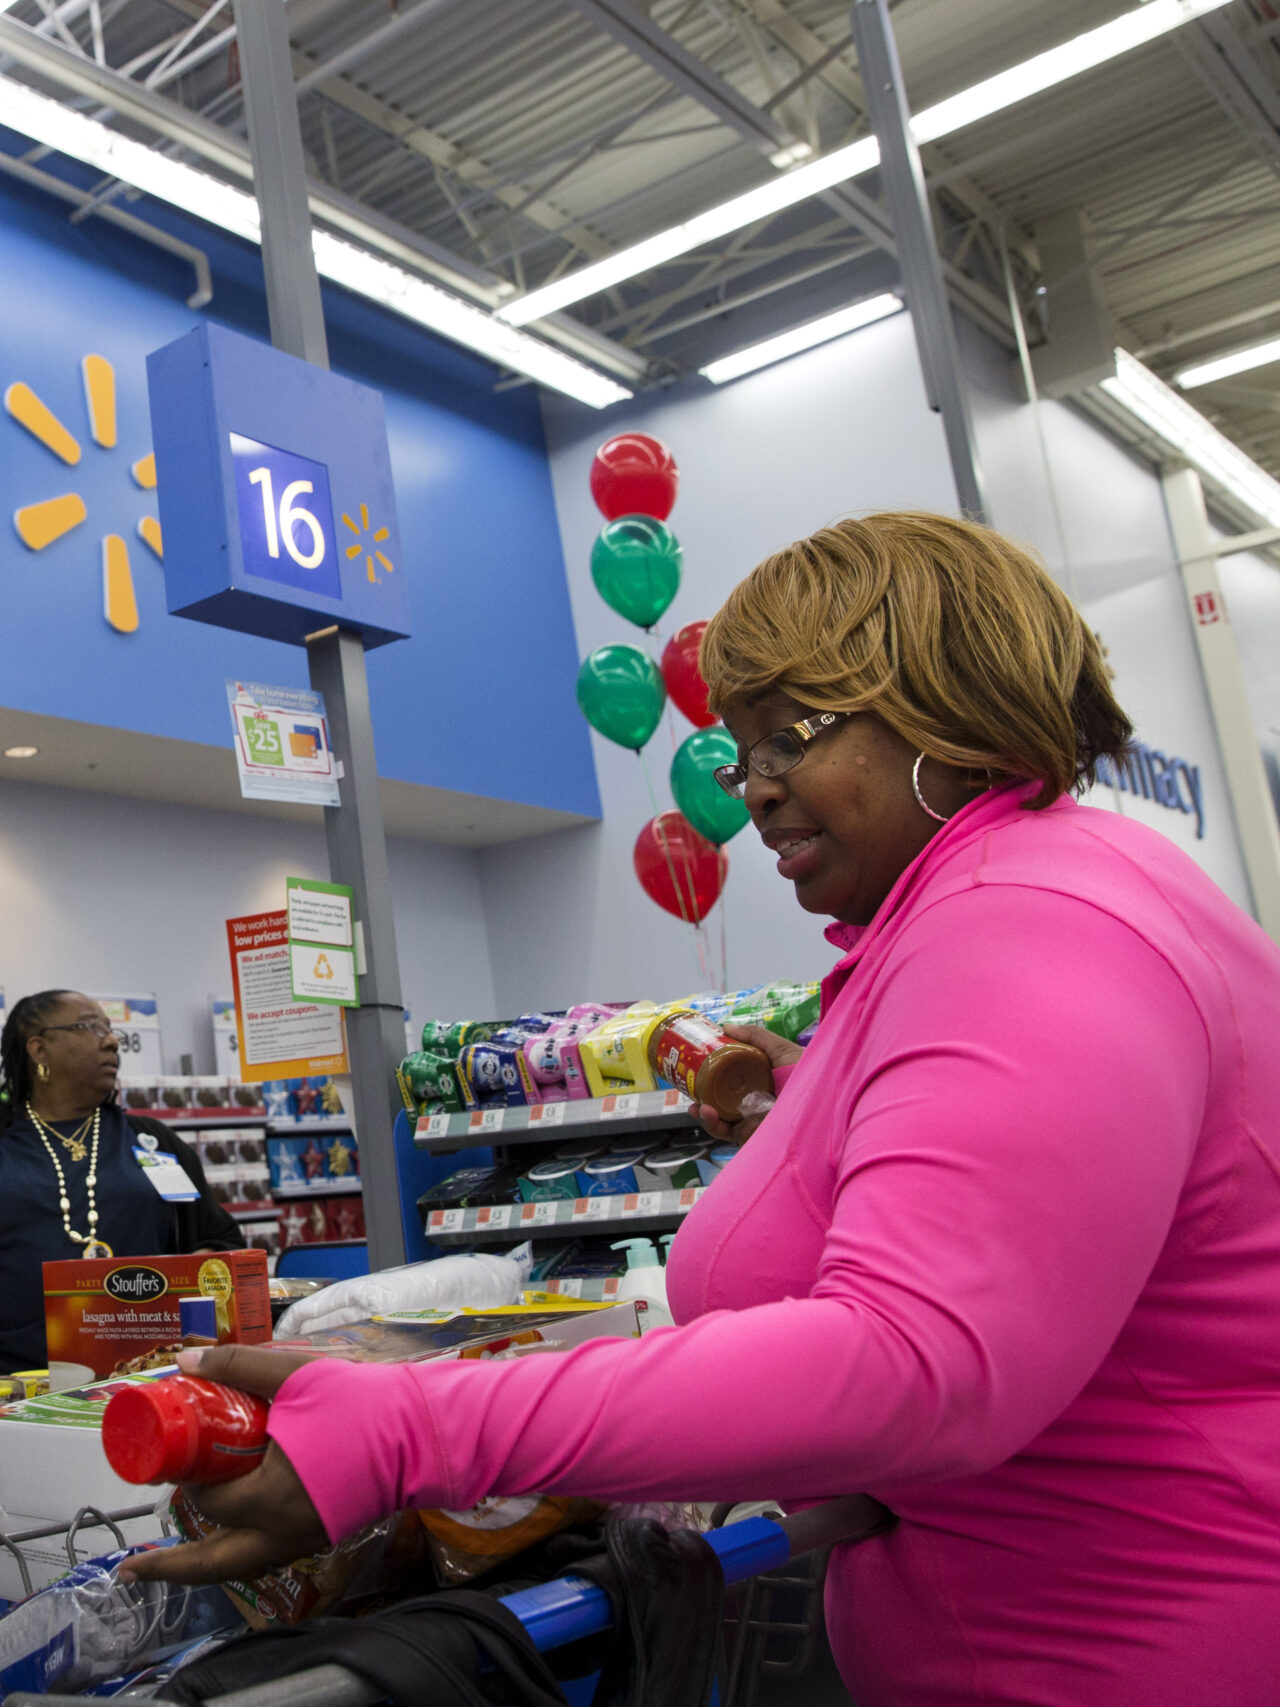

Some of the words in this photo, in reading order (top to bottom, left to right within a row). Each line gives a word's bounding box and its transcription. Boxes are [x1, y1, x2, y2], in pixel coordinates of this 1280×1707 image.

[248, 466, 326, 569] 16
[247, 729, 279, 752] $25
[232, 923, 248, 933] We
[248, 920, 270, 930] work
[234, 934, 252, 946] low
[253, 930, 283, 946] prices
[241, 955, 253, 963] We
[254, 952, 264, 961] ad
[247, 1011, 259, 1020] We
[260, 1008, 285, 1019] accept
[285, 1004, 319, 1016] coupons.
[76, 1279, 101, 1288] PARTY
[111, 1273, 160, 1296] Stouffer's
[170, 1276, 191, 1285] SIZE
[202, 1276, 228, 1284] FAVORITE
[204, 1284, 227, 1292] LASAGNA
[82, 1309, 115, 1327] lasagna
[117, 1308, 138, 1322] with
[140, 1311, 162, 1323] meat
[164, 1311, 172, 1322] &
